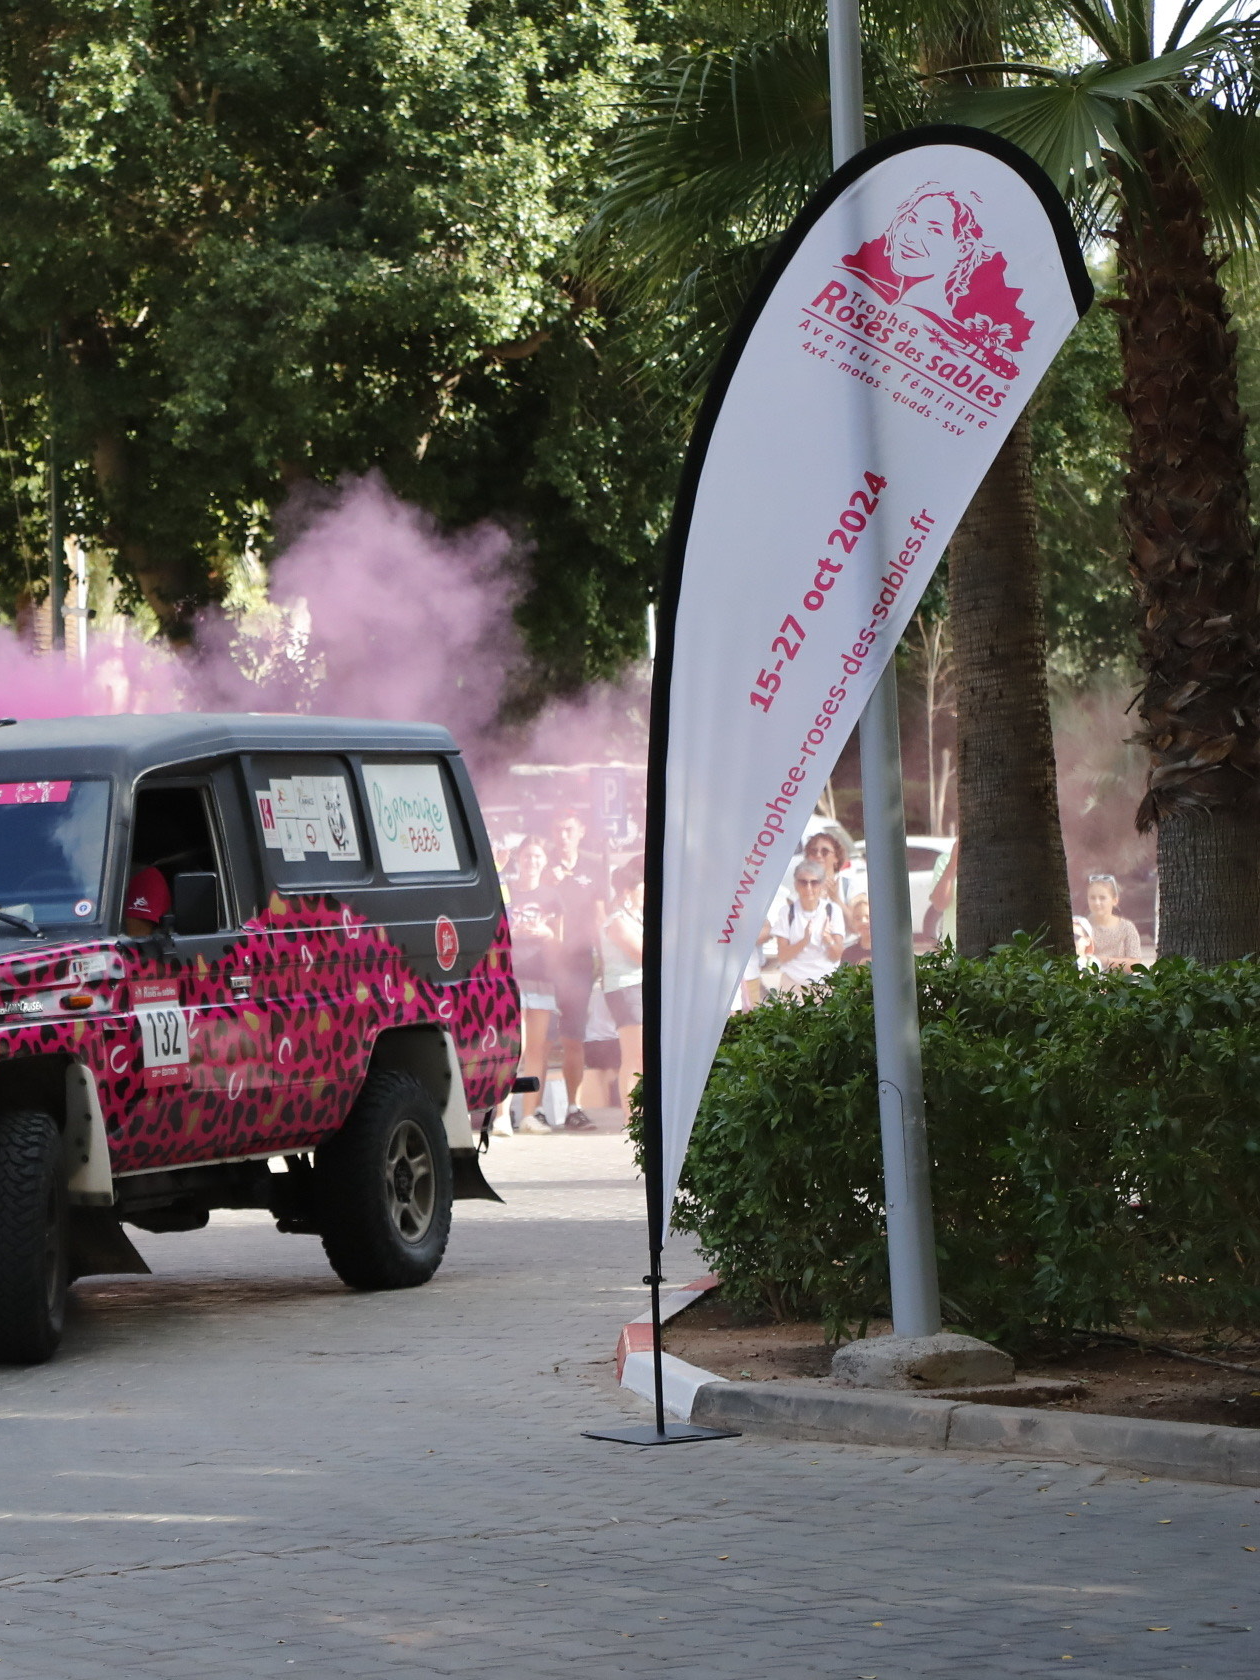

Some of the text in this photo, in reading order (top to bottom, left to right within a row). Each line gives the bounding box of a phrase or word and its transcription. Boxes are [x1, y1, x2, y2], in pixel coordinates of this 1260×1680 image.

[811, 279, 1007, 408] Roses des sables
[851, 291, 919, 338] Trophée
[798, 319, 988, 430] Aventure féminine
[801, 341, 826, 360] 4x4
[838, 361, 881, 389] motos
[892, 391, 932, 418] quads
[942, 420, 965, 436] ssv
[749, 470, 888, 713] 15-27 oct 2024
[717, 508, 936, 944] www.trophee-roses-des-sables.fr
[146, 1010, 181, 1057] 132
